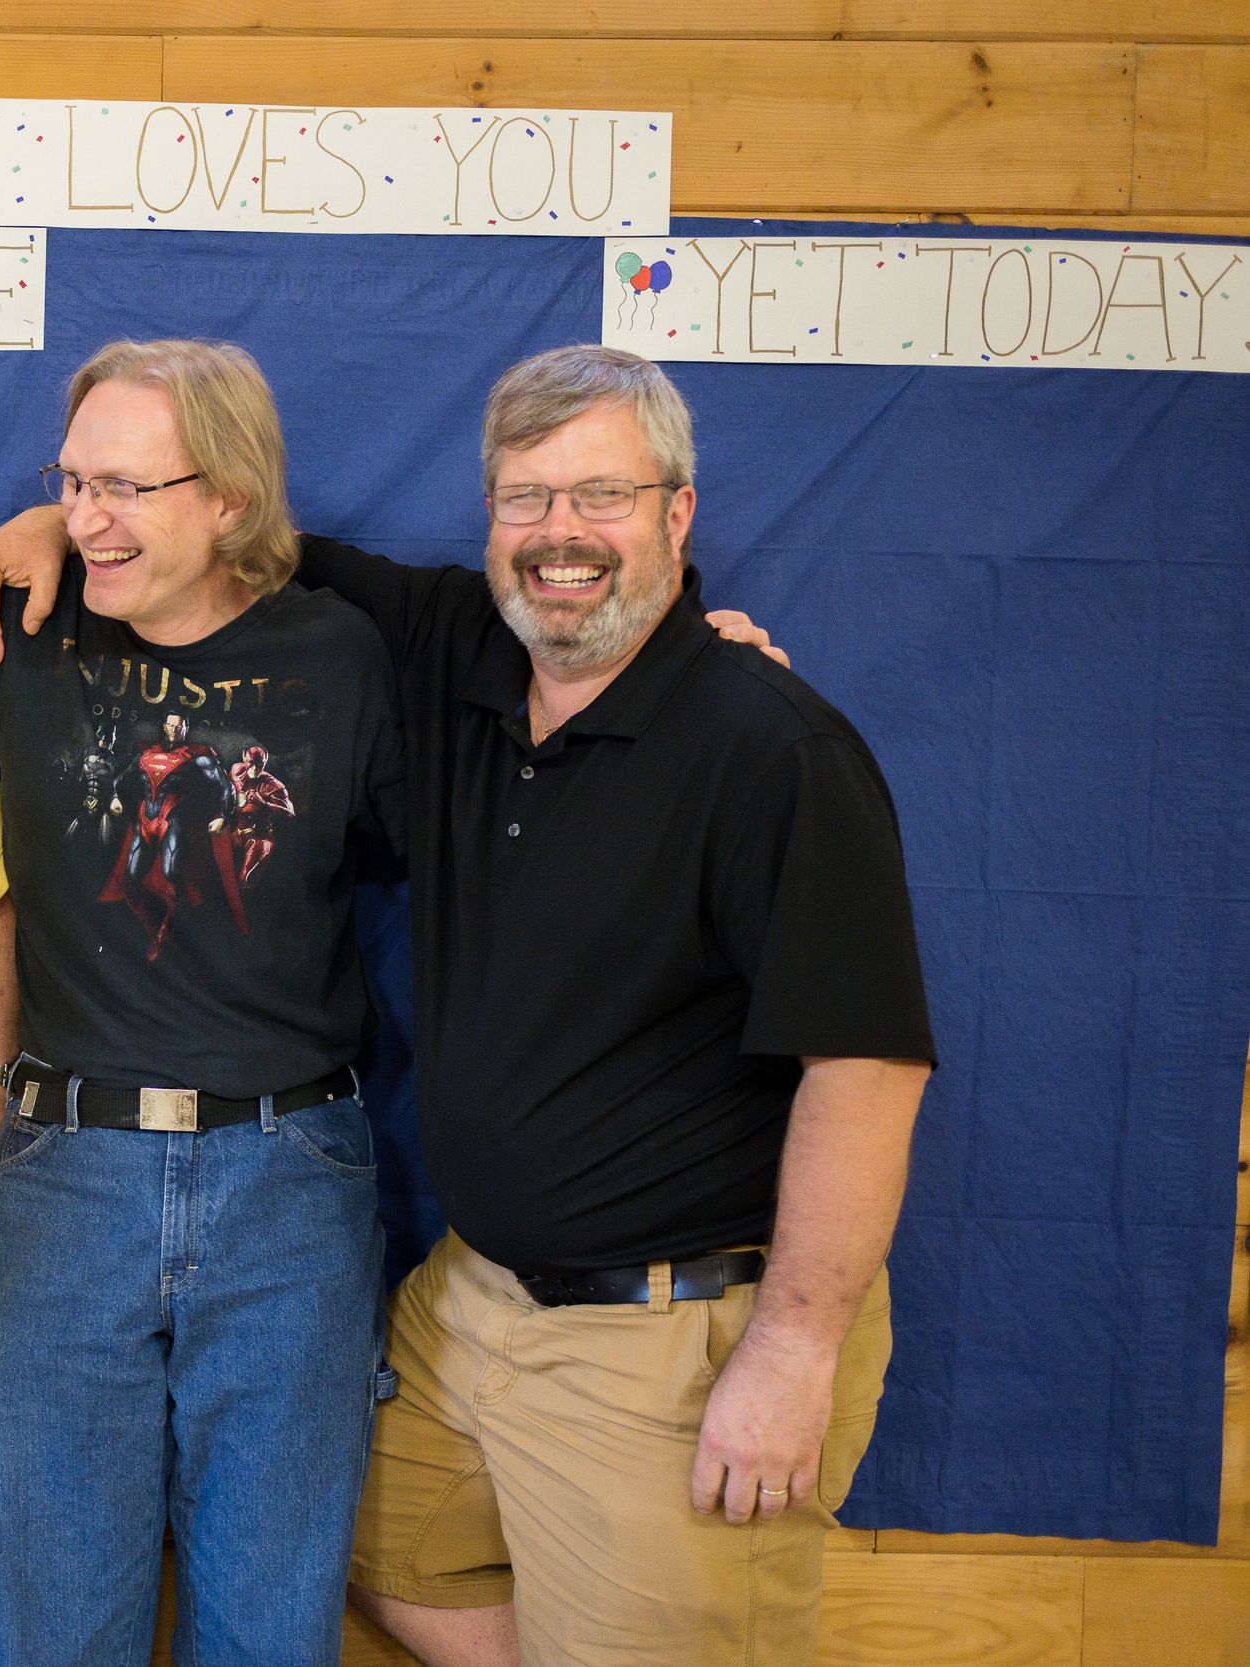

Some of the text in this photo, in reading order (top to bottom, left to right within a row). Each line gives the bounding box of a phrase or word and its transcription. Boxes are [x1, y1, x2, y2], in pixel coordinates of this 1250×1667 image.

[64, 105, 618, 225] LOVES YOU
[685, 239, 1243, 362] YET TODAY
